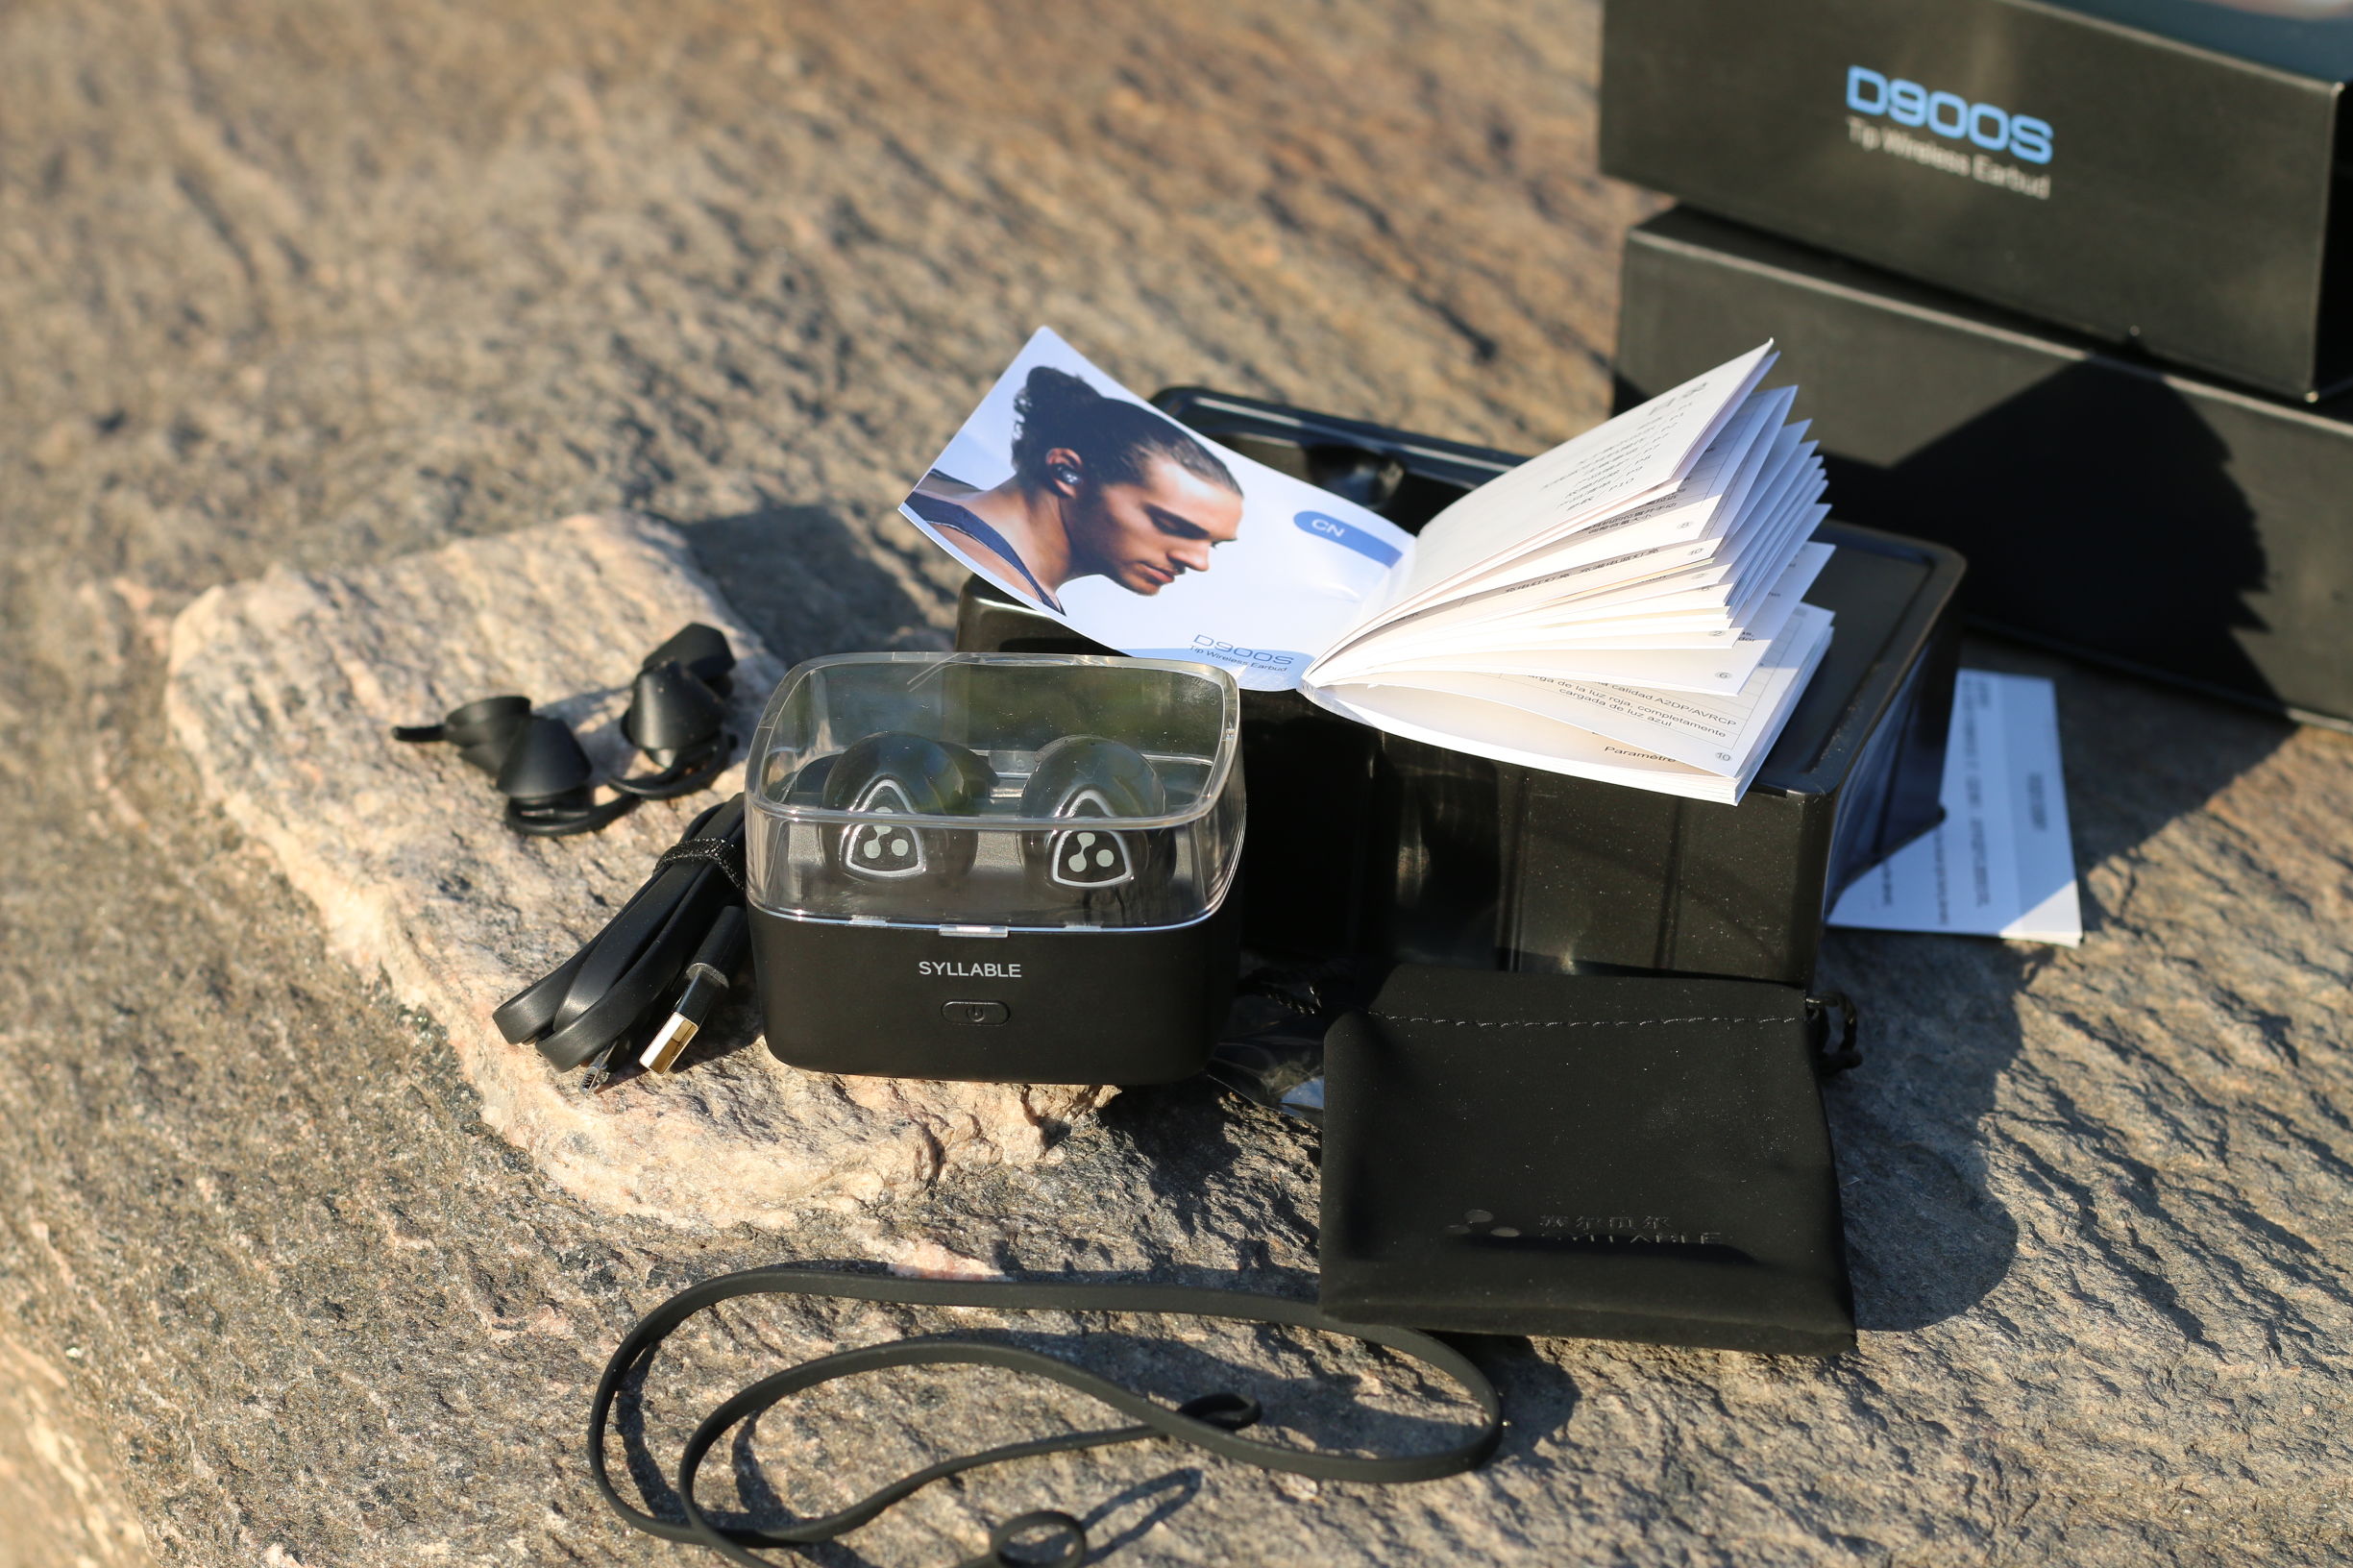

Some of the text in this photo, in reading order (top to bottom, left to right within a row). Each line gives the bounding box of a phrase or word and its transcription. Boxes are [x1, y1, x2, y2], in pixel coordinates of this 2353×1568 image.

[1846, 64, 2054, 164] D900S
[1847, 114, 2051, 200] Tip Wireless Earbud
[1311, 519, 1344, 537] CN
[1190, 645, 1288, 673] Tip Wireless Earbud
[1193, 633, 1295, 666] D900S
[1557, 680, 1573, 689] de
[1590, 689, 1607, 699] luz
[1637, 705, 1727, 738] completamente
[1558, 688, 1672, 727] cargada de luz azul
[1611, 683, 1737, 726] calidad A2DP/AVRCP
[919, 961, 1022, 978] SYLLABLE
